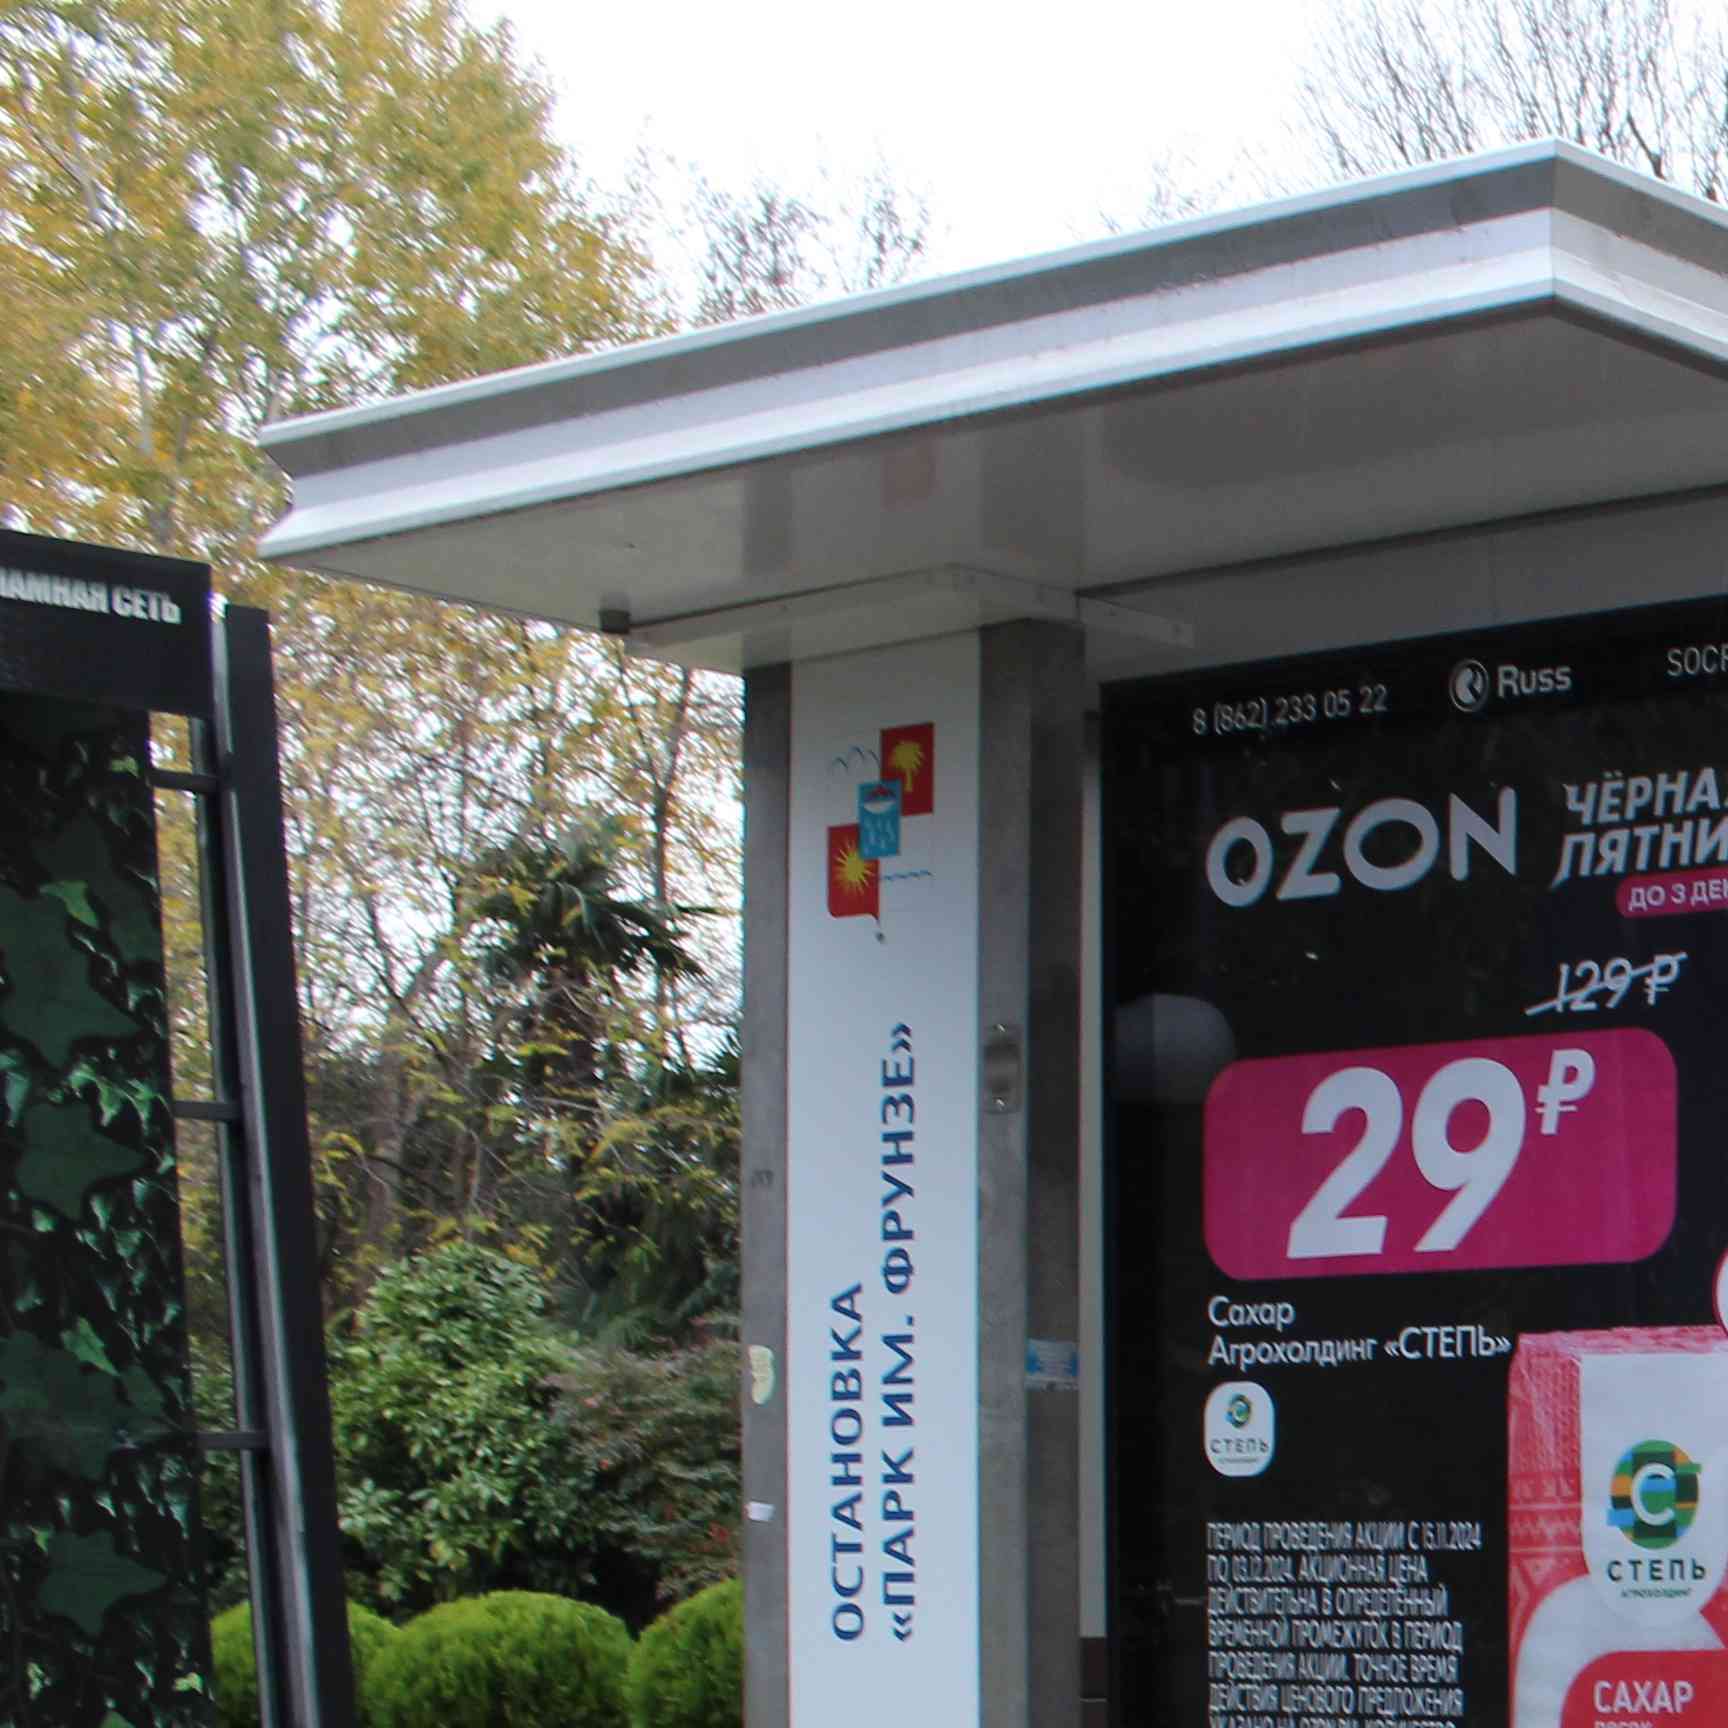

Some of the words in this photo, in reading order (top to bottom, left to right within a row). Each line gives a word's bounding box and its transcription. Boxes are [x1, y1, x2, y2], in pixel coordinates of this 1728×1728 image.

[0, 567, 109, 614] АМНАЯ
[111, 585, 182, 625] СЕТЬ
[1496, 664, 1572, 698] Russ
[1193, 708, 1207, 735] 8
[1213, 696, 1267, 736] (862)
[1273, 693, 1316, 726] 233
[1322, 690, 1350, 718] 05
[1359, 683, 1388, 713] 22
[1205, 786, 1518, 908] OZON
[1627, 886, 1666, 912] ДО
[1671, 883, 1686, 904] 3
[881, 1020, 917, 1295] ФРУНЗЕ»
[1208, 1296, 1295, 1333] Сахар
[1208, 1337, 1378, 1372] Агрохолдинг
[1383, 1324, 1512, 1360] «СТЕПЬ»
[881, 1315, 916, 1427] ИМ.
[831, 1281, 864, 1643] ОСТАНОВКА
[1209, 1438, 1270, 1455] СТЕПЬ
[881, 1447, 916, 1643] «ПАРК
[1207, 1521, 1261, 1551] ПЕРИОД
[1264, 1521, 1352, 1551] ПРОВЕДЕНИЯ
[1207, 1555, 1229, 1582] ПО
[1298, 1554, 1386, 1584] АКЦИОННАЯ
[1388, 1554, 1429, 1588] ЦЕНА
[1607, 1558, 1706, 1581] СТЕПЬ
[1207, 1584, 1319, 1616] ДЕЙСТВИТЕЛЬНА
[1208, 1617, 1289, 1647] ВРЕМЕННОЙ
[1404, 1621, 1464, 1653] ПЕРИОД
[1208, 1651, 1296, 1680] ПРОВЕДЕНИЯ
[1352, 1653, 1408, 1682] ТОЧНОЕ
[1409, 1654, 1459, 1682] ВРЕМЯ
[1209, 1681, 1279, 1712] ДЕЙСТВИЯ
[1358, 1686, 1464, 1717] ПРЕДЛОЖЕНИЯ
[1593, 1680, 1695, 1714] САХАР
